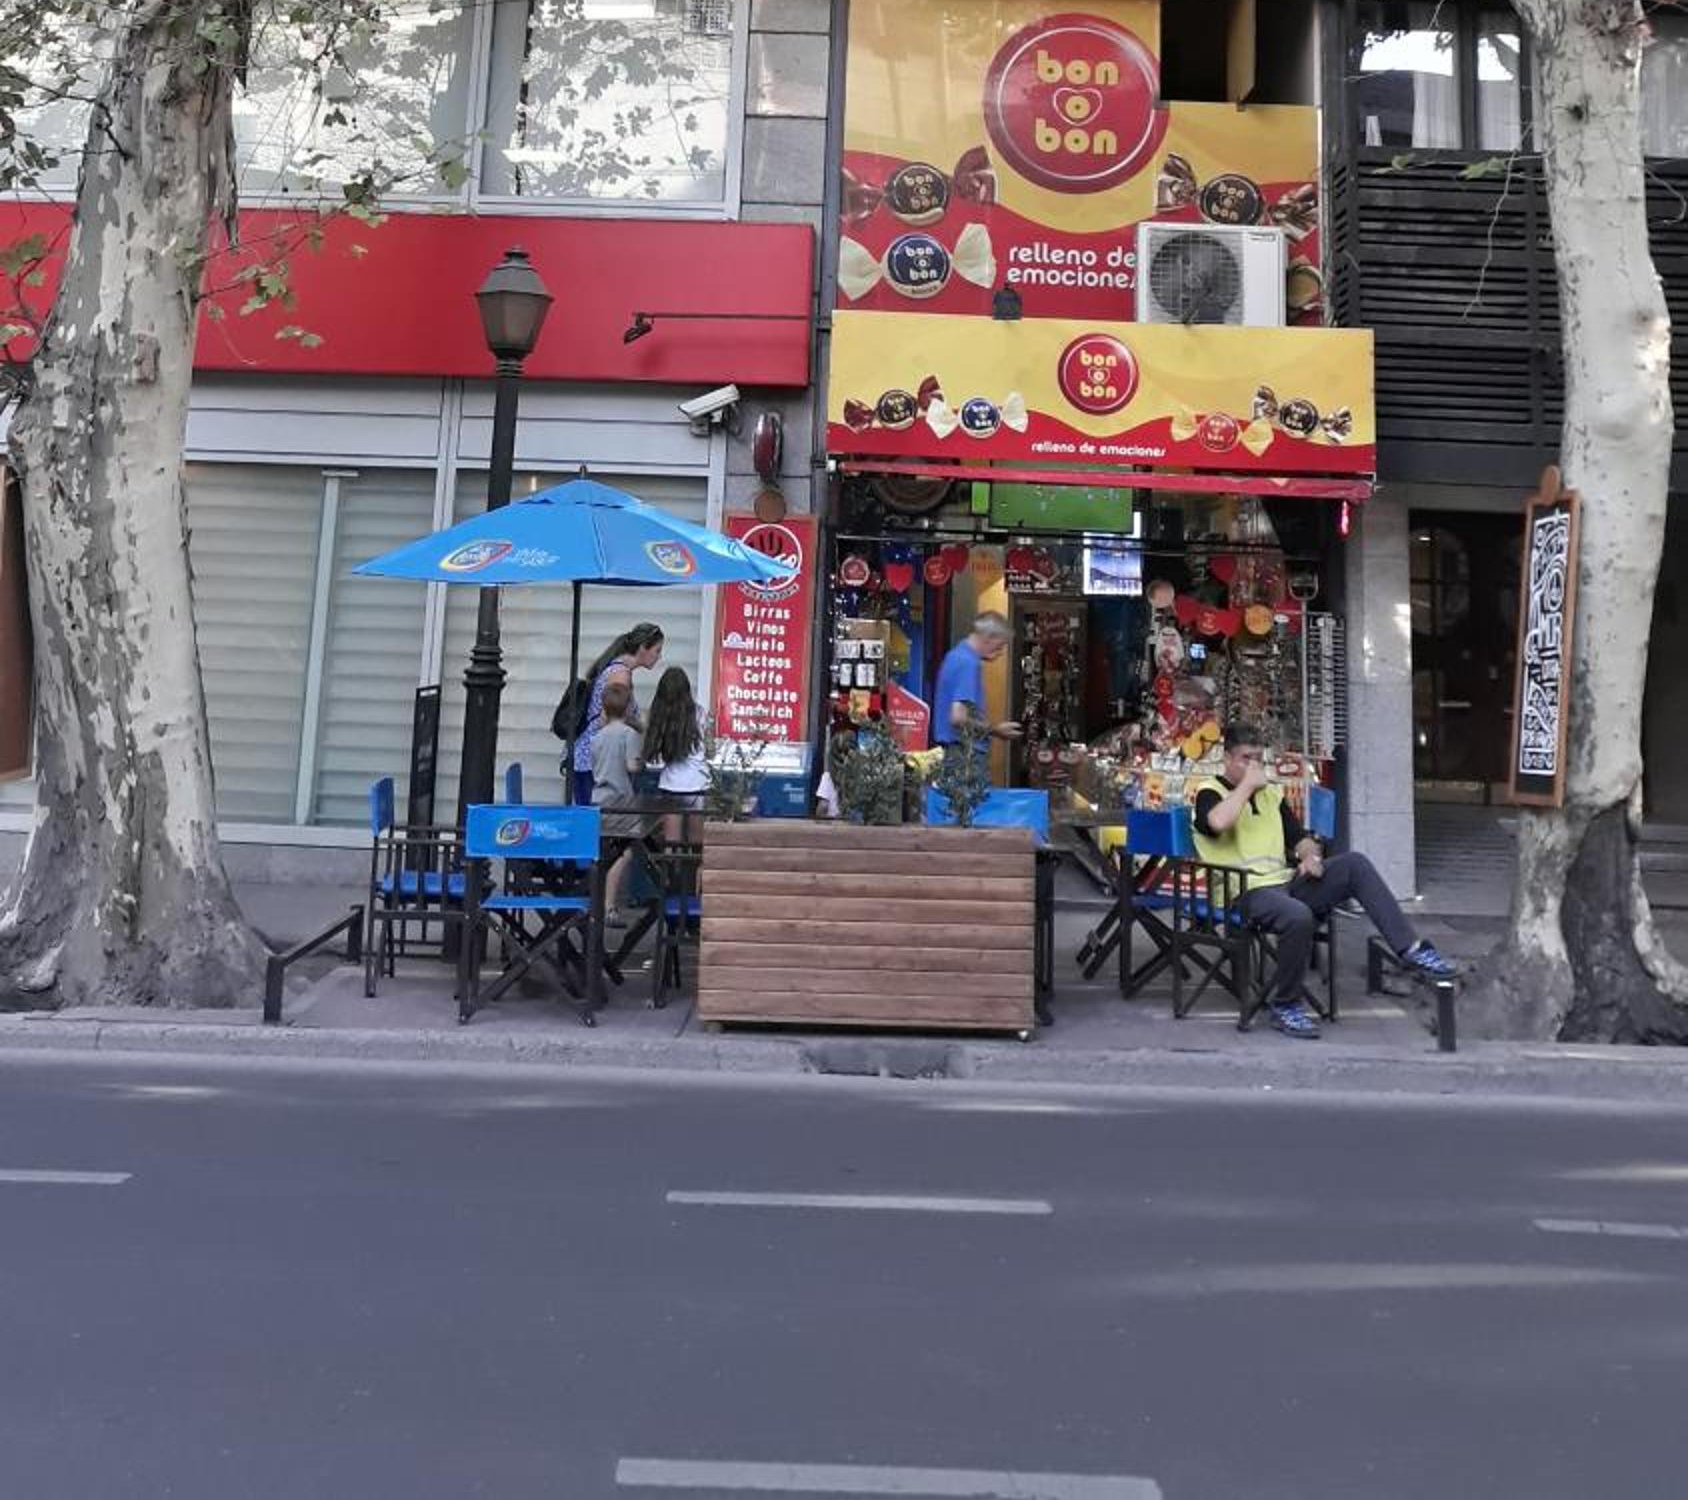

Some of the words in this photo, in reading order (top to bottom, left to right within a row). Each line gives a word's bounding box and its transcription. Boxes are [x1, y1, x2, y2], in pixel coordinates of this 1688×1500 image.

[1036, 49, 1119, 85] bon
[1065, 95, 1091, 119] o
[1035, 117, 1118, 155] bon
[904, 245, 935, 257] bon
[1009, 242, 1097, 266] relleno
[1107, 245, 1136, 268] de
[909, 267, 938, 281] bon
[1080, 349, 1118, 367] bon
[1080, 381, 1118, 399] bon
[1031, 440, 1076, 453] relleno
[1079, 441, 1096, 454] de
[1100, 443, 1167, 458] emociones
[743, 603, 791, 620] Birras
[747, 620, 786, 636] Vinos
[736, 651, 792, 669] Lacteos
[727, 684, 798, 703] Chocolate
[730, 701, 793, 719] Sandwich
